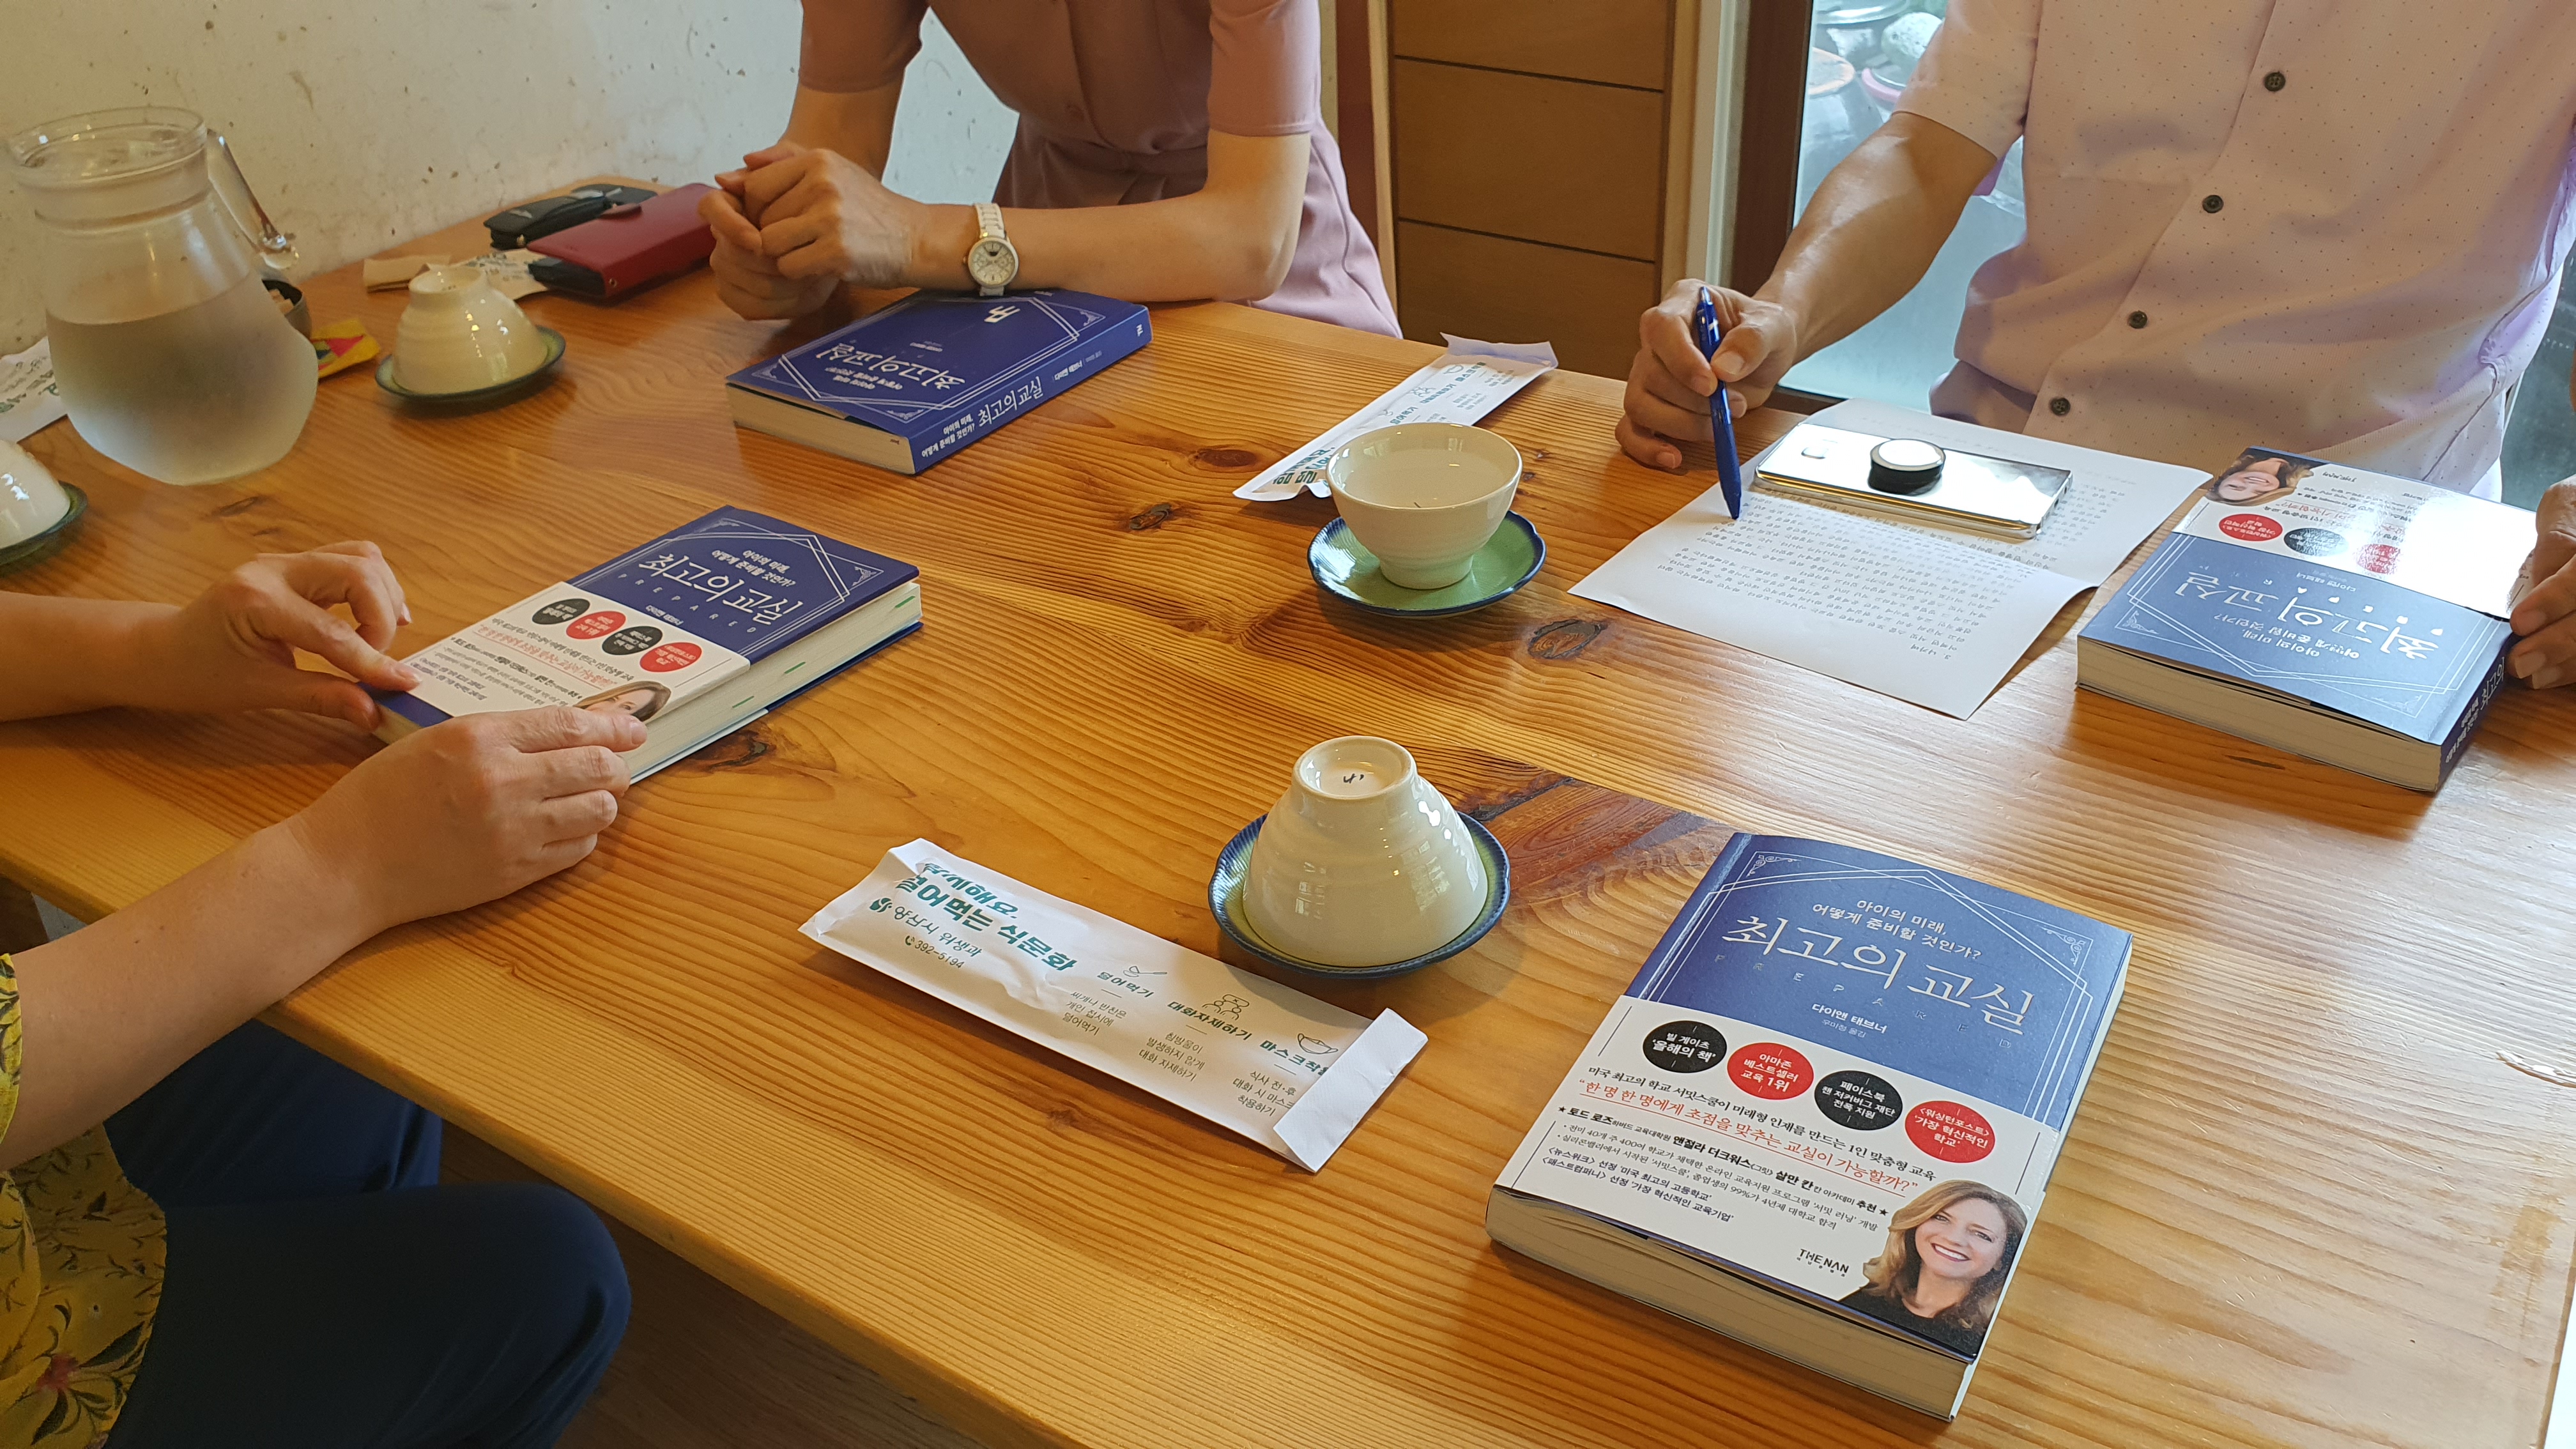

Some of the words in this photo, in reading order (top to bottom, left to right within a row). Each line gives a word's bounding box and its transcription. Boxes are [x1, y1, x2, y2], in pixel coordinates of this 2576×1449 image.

[868, 355, 964, 388] 최고의
[978, 390, 1016, 426] 최고의
[1017, 376, 1043, 404] 교실
[639, 554, 744, 601] 최고의
[723, 588, 802, 624] 교실
[2175, 572, 2278, 611] 교실
[2214, 613, 2264, 630] 것인가?
[2278, 597, 2437, 658] 최고의
[894, 906, 939, 934] 양산시
[939, 932, 981, 956] 위생과
[897, 875, 1004, 930] 덜어먹는
[998, 925, 1075, 970] 식문화
[1813, 904, 1862, 924] 어떻게
[1866, 917, 1915, 940] 준비할
[1922, 934, 1982, 959] 것인가?
[1857, 900, 1906, 921] 아이의
[1911, 916, 1945, 935] 미래,
[914, 940, 964, 968] 392-5194
[1097, 972, 1153, 997] 덜어먹기
[1724, 916, 1905, 988] 최고의
[1908, 965, 2032, 1034] 교실
[1062, 1012, 1100, 1035] 덜어먹기
[1066, 1001, 1085, 1013] 개인
[1085, 1009, 1114, 1026] 접시에
[1098, 1002, 1126, 1018] 반찬은
[1168, 1001, 1251, 1039] 대화자제하기
[1812, 1004, 1848, 1020] 다이앤
[1850, 1016, 1887, 1033] 태브너
[1146, 1037, 1184, 1060] 발생하지
[1184, 1055, 1205, 1070] 않게
[1165, 1032, 1202, 1054] 침방울이
[1666, 1032, 1677, 1041] 빌
[1678, 1036, 1709, 1049] 게이츠
[1138, 1049, 1158, 1063] 대화
[1158, 1059, 1196, 1081] 자제하기
[1744, 1059, 1798, 1082] 베스트셀러
[1759, 1054, 1791, 1070] 아마존
[1232, 1078, 1253, 1092] 대화
[1254, 1088, 1266, 1098] 시
[1250, 1071, 1269, 1085] 식사
[1740, 1070, 1763, 1082] 교육
[1767, 1077, 1789, 1092] 1위
[1840, 1081, 1885, 1102] 페이스북
[1238, 1094, 1275, 1116] 착용하기
[1833, 1099, 1853, 1111] 전폭
[1855, 1107, 1875, 1119] 지원
[1834, 1090, 1872, 1108] 저커버그
[1874, 1104, 1895, 1116] 재단
[1588, 1067, 1611, 1078] 미국
[1611, 1072, 1646, 1086] 최고의
[1648, 1080, 1671, 1092] 학교
[1673, 1087, 1730, 1110] 서밋스쿨이
[1733, 1105, 1768, 1123] 미래형
[1770, 1117, 1805, 1135] 인재를
[1809, 1130, 1845, 1149] 만드는
[1848, 1145, 1867, 1158] 1인
[1870, 1151, 1908, 1171] 맞춤형
[1909, 1165, 1936, 1181] 교육
[1604, 1085, 1618, 1098] 명
[1621, 1090, 1636, 1102] 한
[1639, 1094, 1684, 1115] 명에게
[1685, 1108, 1731, 1131] 초점을
[1735, 1123, 1781, 1147] 맞추는
[1784, 1141, 1832, 1165] 교실이
[1939, 1125, 1989, 1148] 혁신적인
[1567, 1107, 1590, 1119] 토드
[1673, 1136, 1705, 1153] 앤절라
[1775, 1170, 1798, 1185] 살만
[1801, 1179, 1813, 1190] 칸
[1856, 1200, 1876, 1213] 추천
[1598, 1160, 1617, 1170] 선정
[1641, 1173, 1670, 1188] 최고의
[1609, 1176, 1629, 1186] 선정
[1654, 1189, 1691, 1207] 혁신적인
[1772, 1188, 1810, 1207] 프로그램
